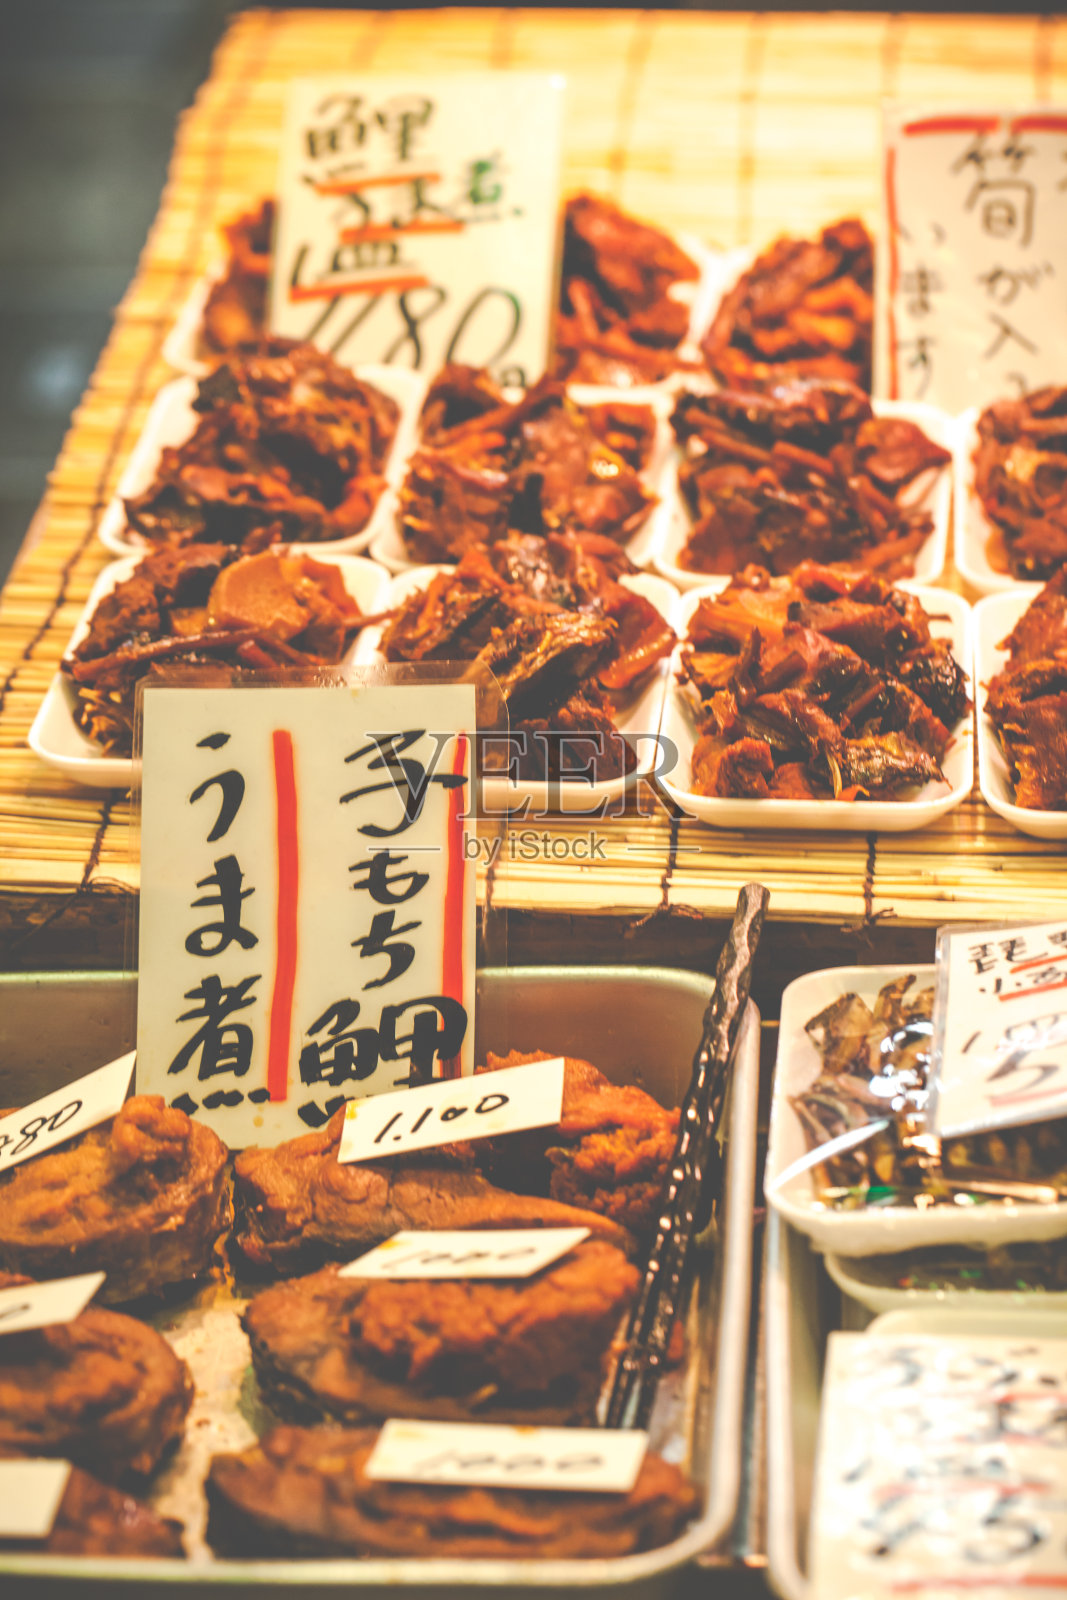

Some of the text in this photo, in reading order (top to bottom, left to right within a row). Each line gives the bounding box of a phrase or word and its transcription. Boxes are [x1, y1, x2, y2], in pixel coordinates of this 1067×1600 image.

[168, 730, 271, 1116] うま煮
[298, 729, 469, 1128] 子もち鯉
